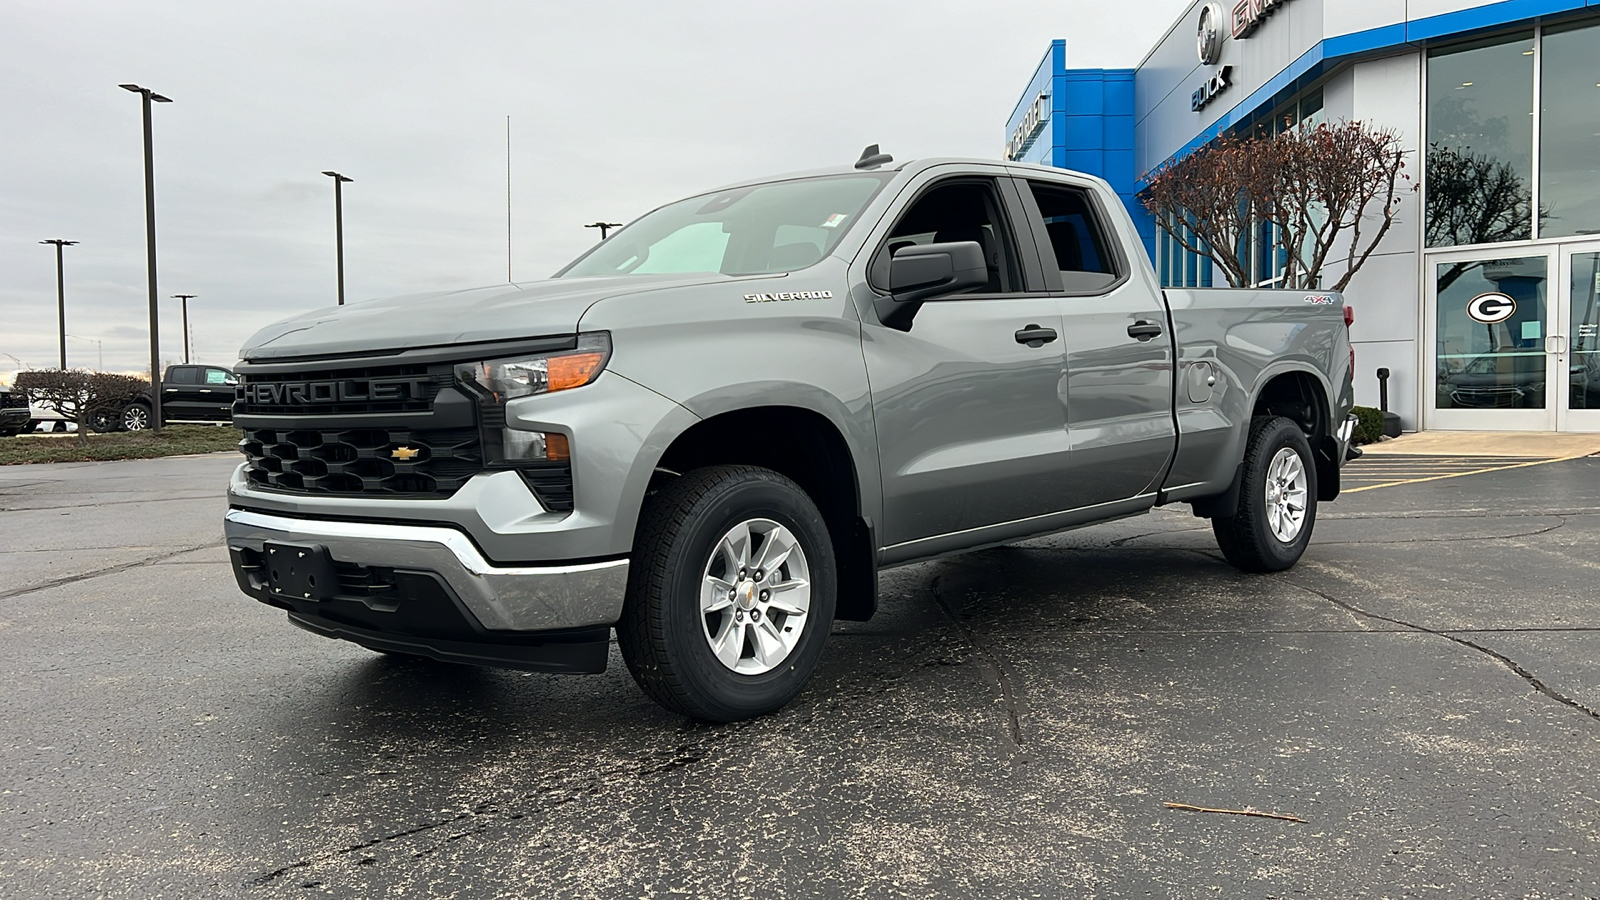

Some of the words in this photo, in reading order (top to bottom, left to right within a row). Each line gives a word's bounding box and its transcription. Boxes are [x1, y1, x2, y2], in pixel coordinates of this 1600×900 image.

[1191, 65, 1233, 112] BUICK
[744, 289, 833, 303] SILVERADO
[1469, 294, 1514, 322] G
[234, 376, 439, 405] CHEVROLET
